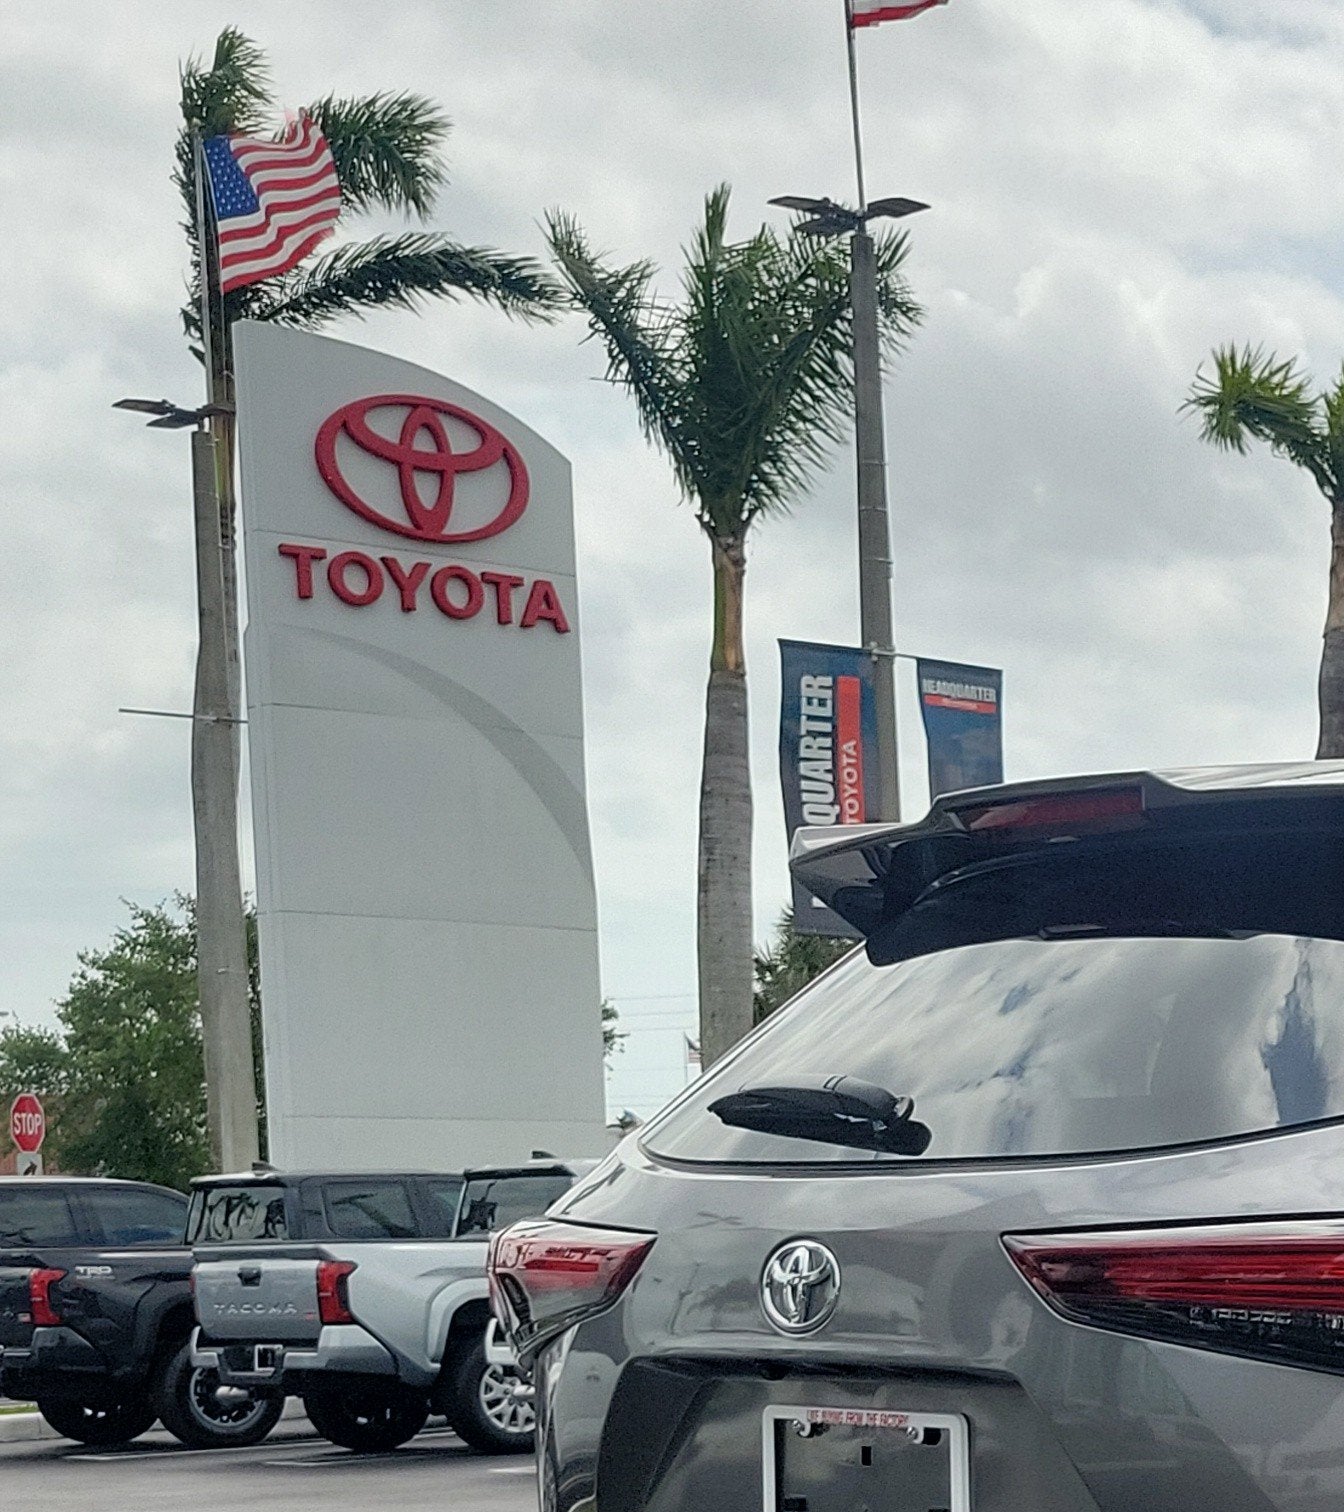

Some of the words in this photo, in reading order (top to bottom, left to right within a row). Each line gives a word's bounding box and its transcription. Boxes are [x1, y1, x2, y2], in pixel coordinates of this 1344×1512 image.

[277, 542, 572, 634] TOYOTA
[800, 674, 840, 826] QUARTER
[13, 1112, 42, 1136] STOP
[213, 1302, 298, 1315] TACOMA
